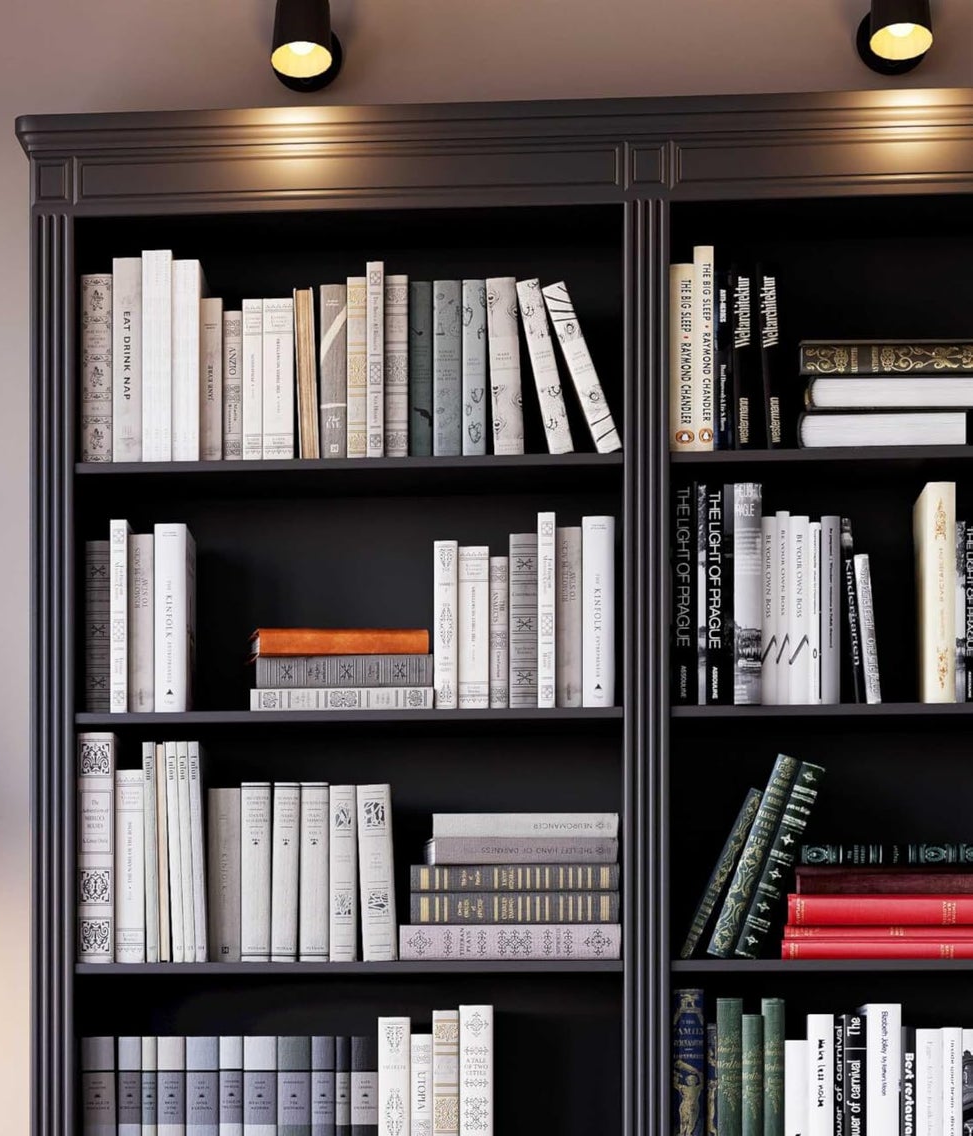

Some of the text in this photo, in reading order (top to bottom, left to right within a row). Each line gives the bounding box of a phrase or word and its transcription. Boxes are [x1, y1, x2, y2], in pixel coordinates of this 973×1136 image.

[734, 276, 750, 348] Weltarchitektur
[760, 276, 779, 348] Weltarchitektur
[681, 280, 691, 424] THE BIG SLEEP RAYMOND CHANDLER
[677, 487, 690, 516] THE
[709, 491, 721, 519] THE
[677, 519, 690, 559] LIGHT
[709, 523, 721, 563] LIGHT
[677, 563, 690, 582] OF
[709, 566, 721, 585] OF
[677, 586, 690, 646] PRAGUE
[709, 589, 721, 649] PRAGUE
[846, 559, 860, 665] Kindergarten
[847, 1017, 861, 1036] The
[835, 1025, 843, 1081] carnival
[905, 1053, 914, 1078] Best
[835, 1084, 843, 1101] of
[847, 1060, 861, 1099] carnival
[847, 1101, 861, 1113] of
